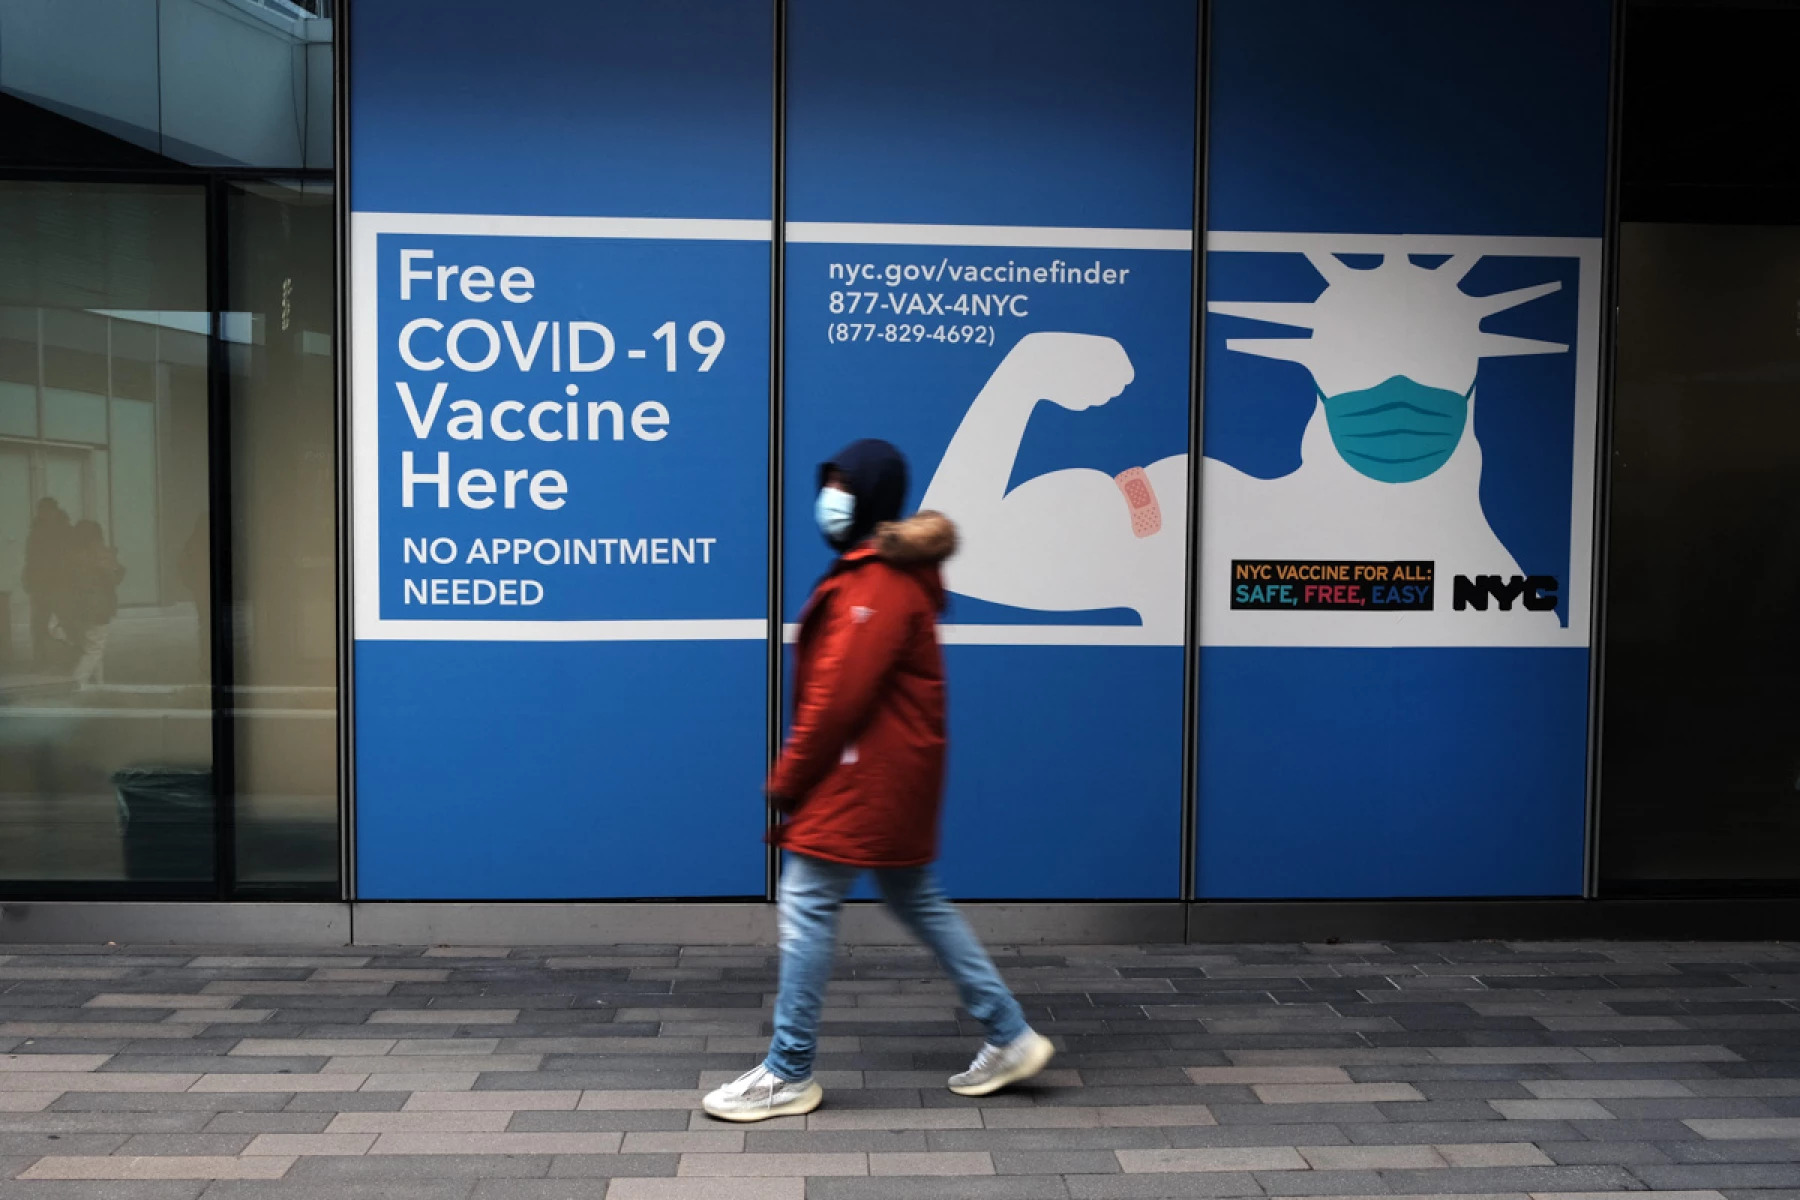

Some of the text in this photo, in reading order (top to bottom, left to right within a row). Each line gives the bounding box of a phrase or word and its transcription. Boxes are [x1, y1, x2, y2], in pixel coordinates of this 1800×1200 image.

[400, 249, 535, 303] Free
[829, 258, 1130, 287] nyc.gov/vaccinefinder
[829, 291, 1029, 317] 877-VAX-4NYC
[827, 323, 996, 347] (877-829-4692)
[395, 382, 670, 441] Vaccine
[402, 451, 568, 510] Here
[403, 538, 717, 565] NO APPOINTMENT
[1236, 565, 1432, 581] NYC VACCINE FOR ALL:
[403, 579, 544, 606] NEEDED
[1235, 584, 1429, 606] SAFE, FREE, EASY
[1453, 575, 1558, 611] NYC
